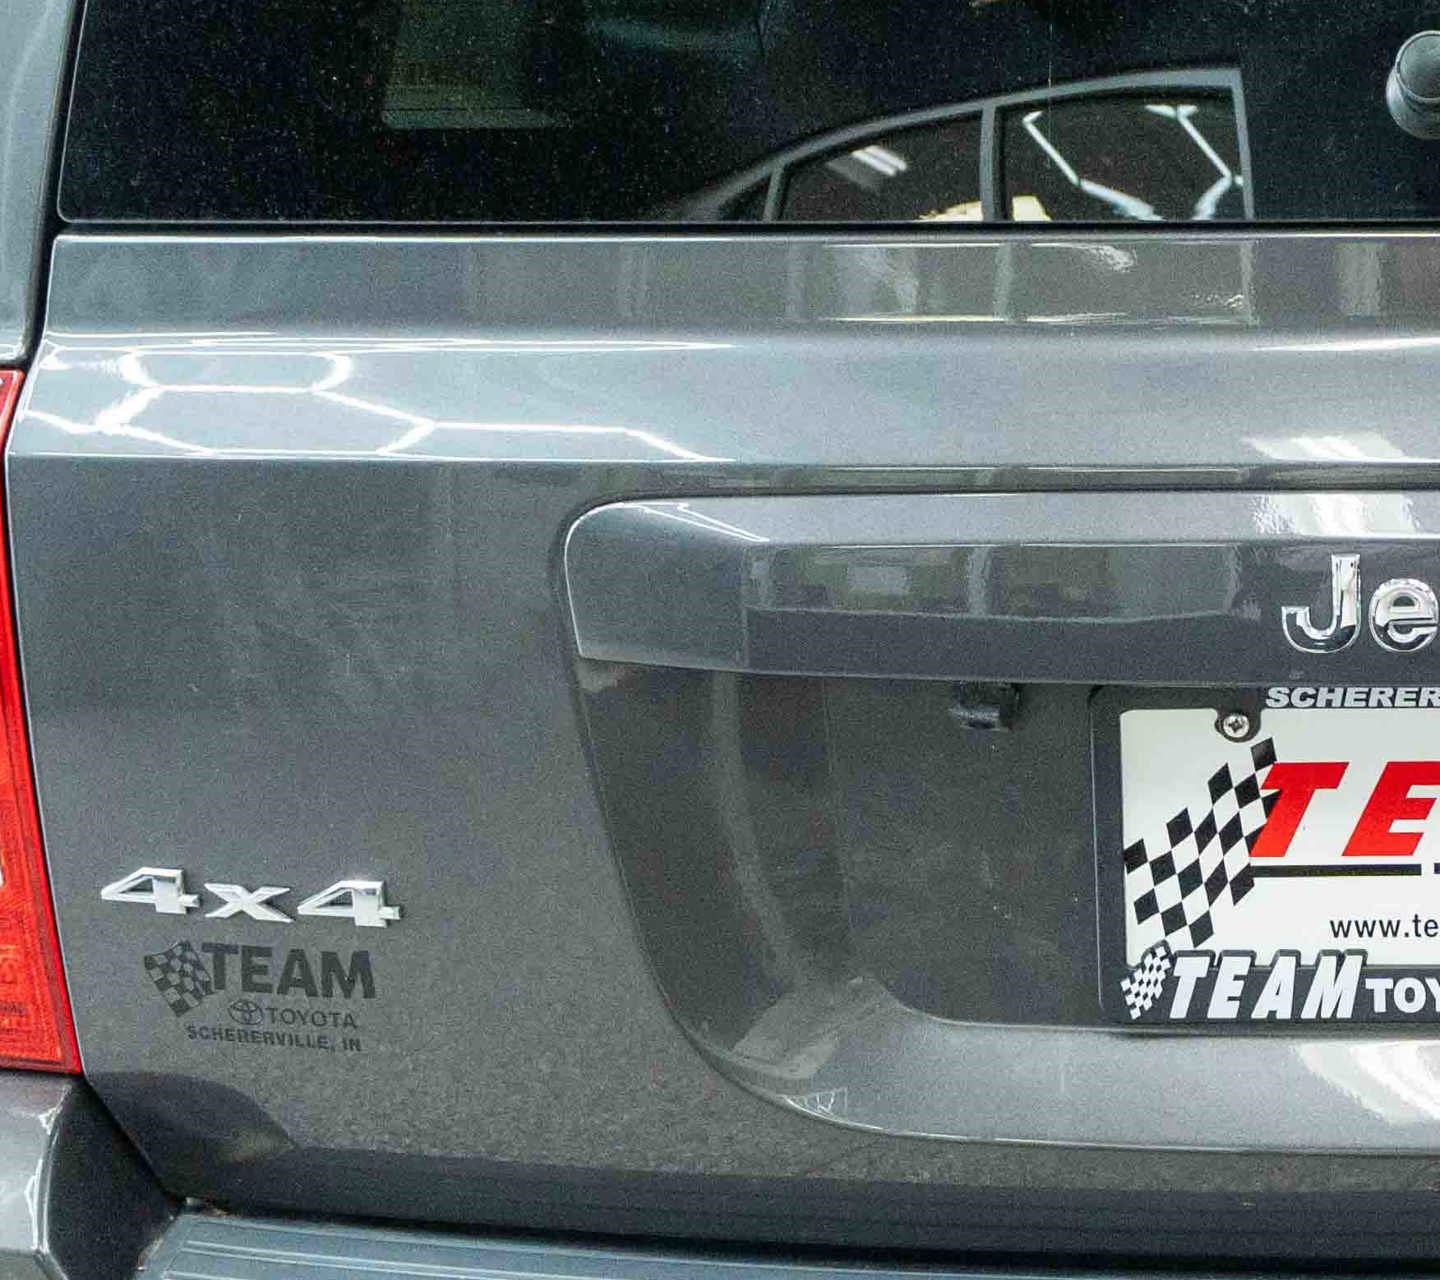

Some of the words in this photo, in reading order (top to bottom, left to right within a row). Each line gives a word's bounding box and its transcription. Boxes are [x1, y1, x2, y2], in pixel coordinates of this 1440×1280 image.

[100, 866, 401, 929] 4x4
[200, 941, 377, 1000] TEAM
[1169, 954, 1368, 1021] TEAM
[187, 1025, 335, 1052] SCHERERVILLE,
[342, 1036, 362, 1053] IN
[265, 1006, 358, 1030] TOYOTA
